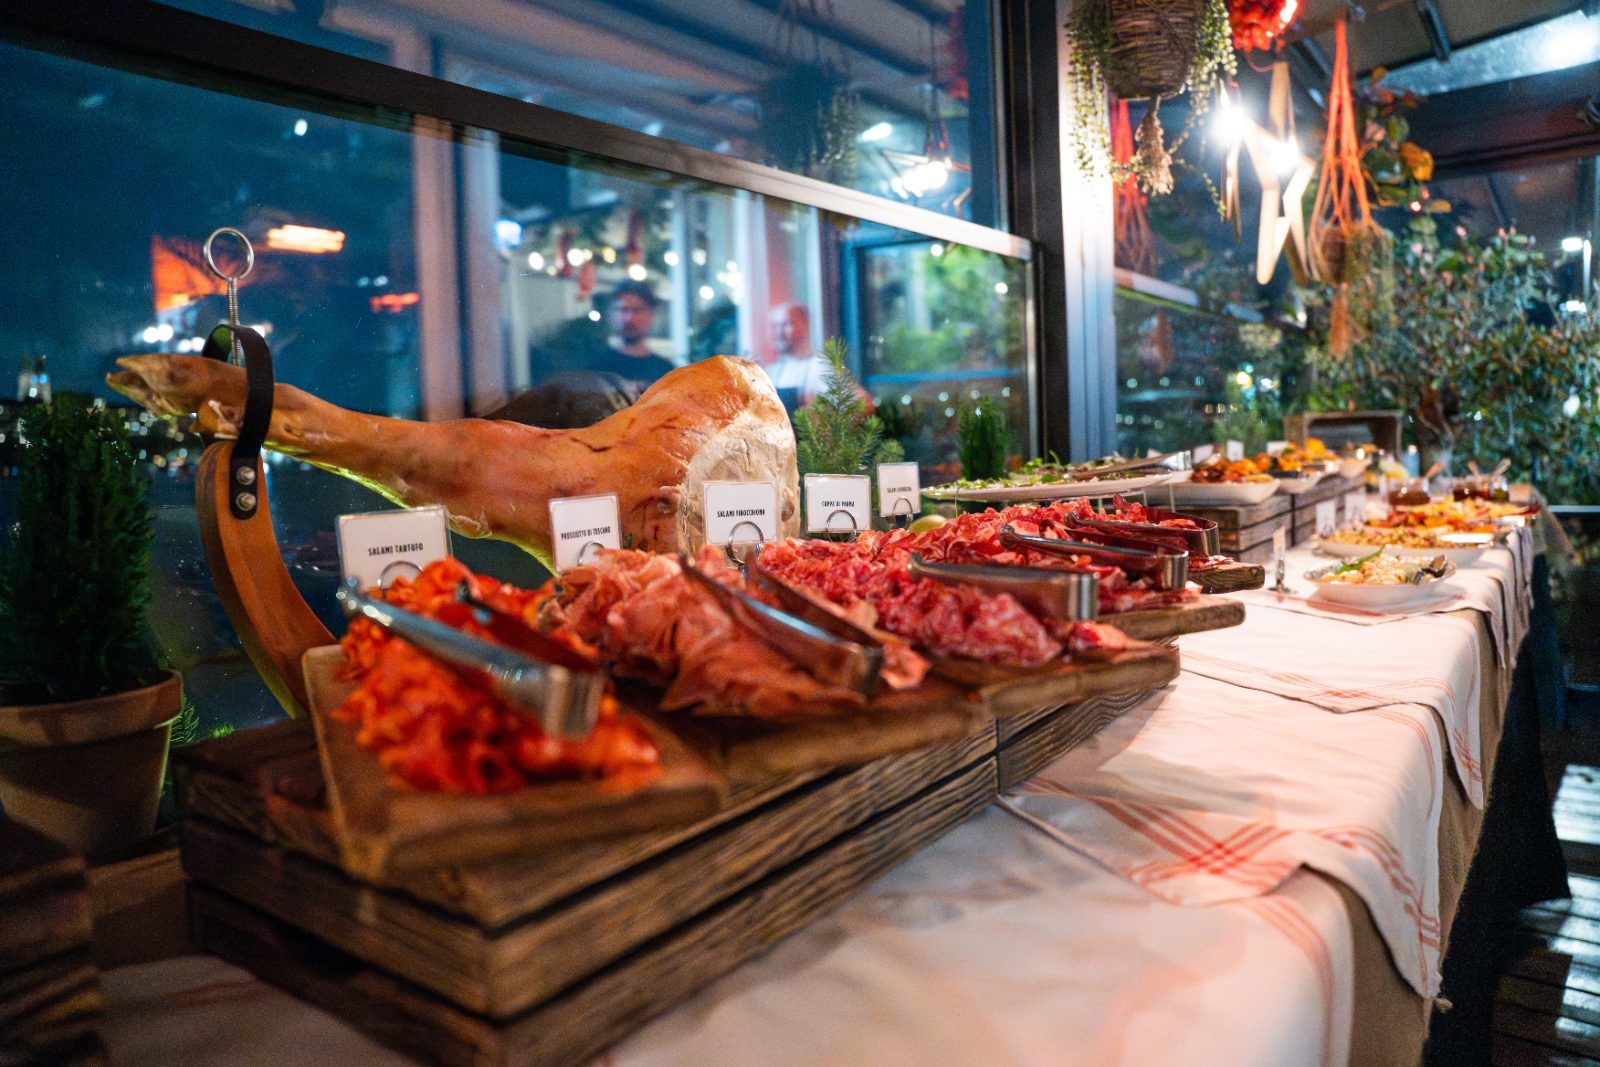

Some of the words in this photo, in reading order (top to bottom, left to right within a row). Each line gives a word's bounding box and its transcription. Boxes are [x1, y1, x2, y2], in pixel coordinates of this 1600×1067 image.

[561, 529, 586, 540] PROSCIUTTO
[593, 526, 610, 535] TOSCANO
[368, 546, 393, 556] SALAMI
[395, 542, 423, 553] TARTUFO
